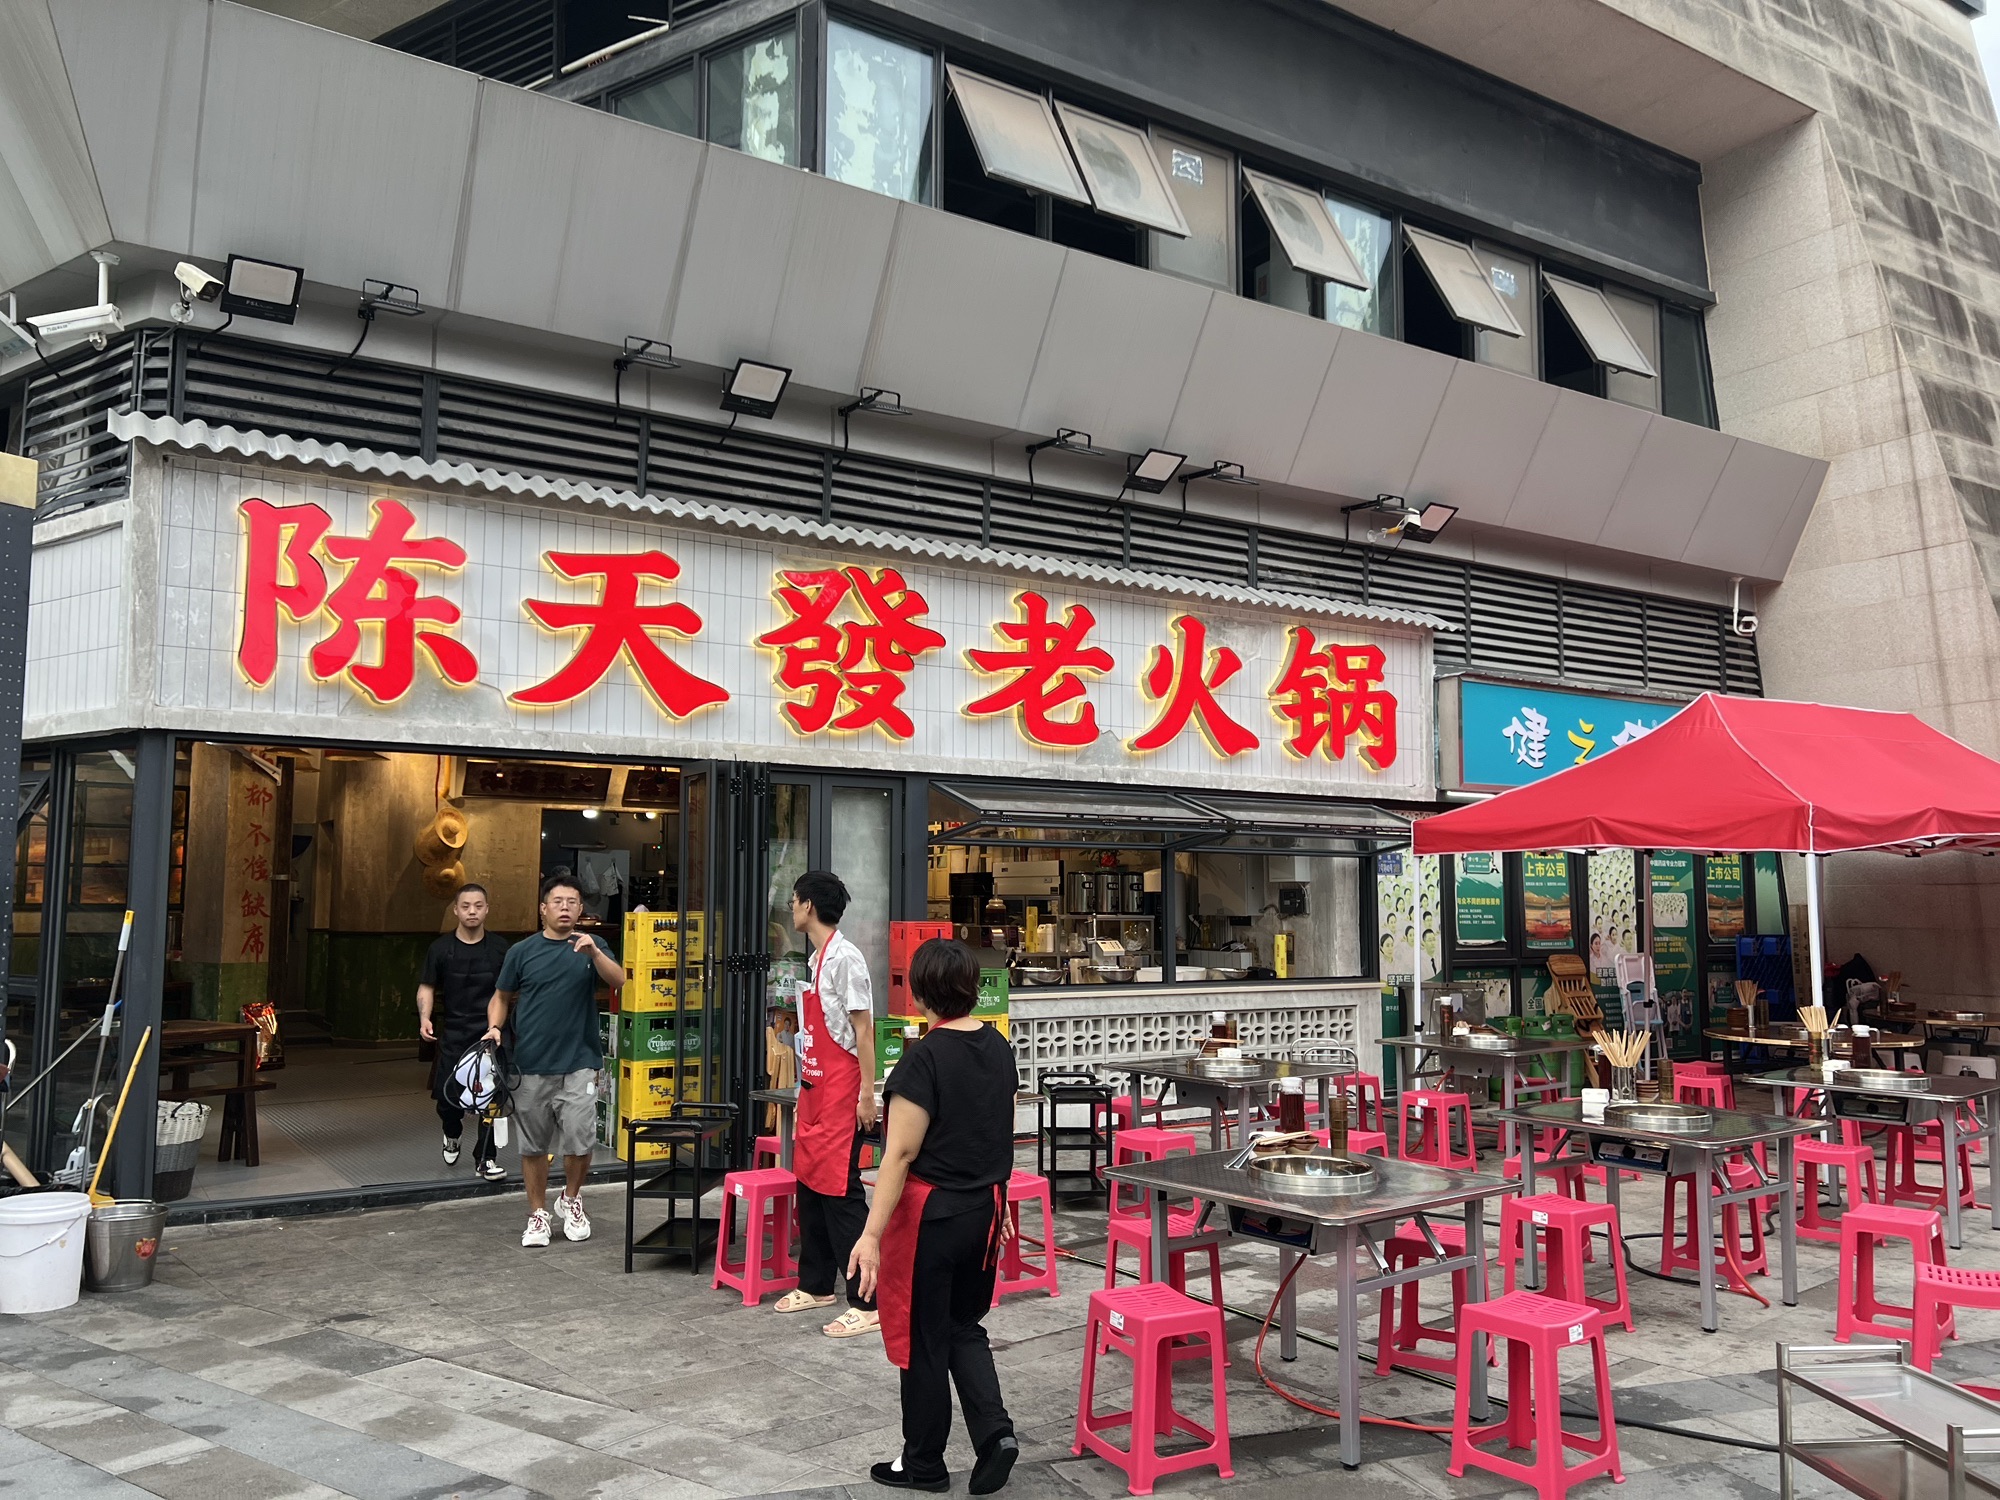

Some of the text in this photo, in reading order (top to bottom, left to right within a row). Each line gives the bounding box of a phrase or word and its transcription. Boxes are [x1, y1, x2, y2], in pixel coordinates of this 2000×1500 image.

[237, 496, 1398, 769] 陈天發老火锅
[240, 750, 274, 964] 都不准缺席
[1525, 861, 1566, 878] 上市公司
[1706, 866, 1740, 881] 上市公司
